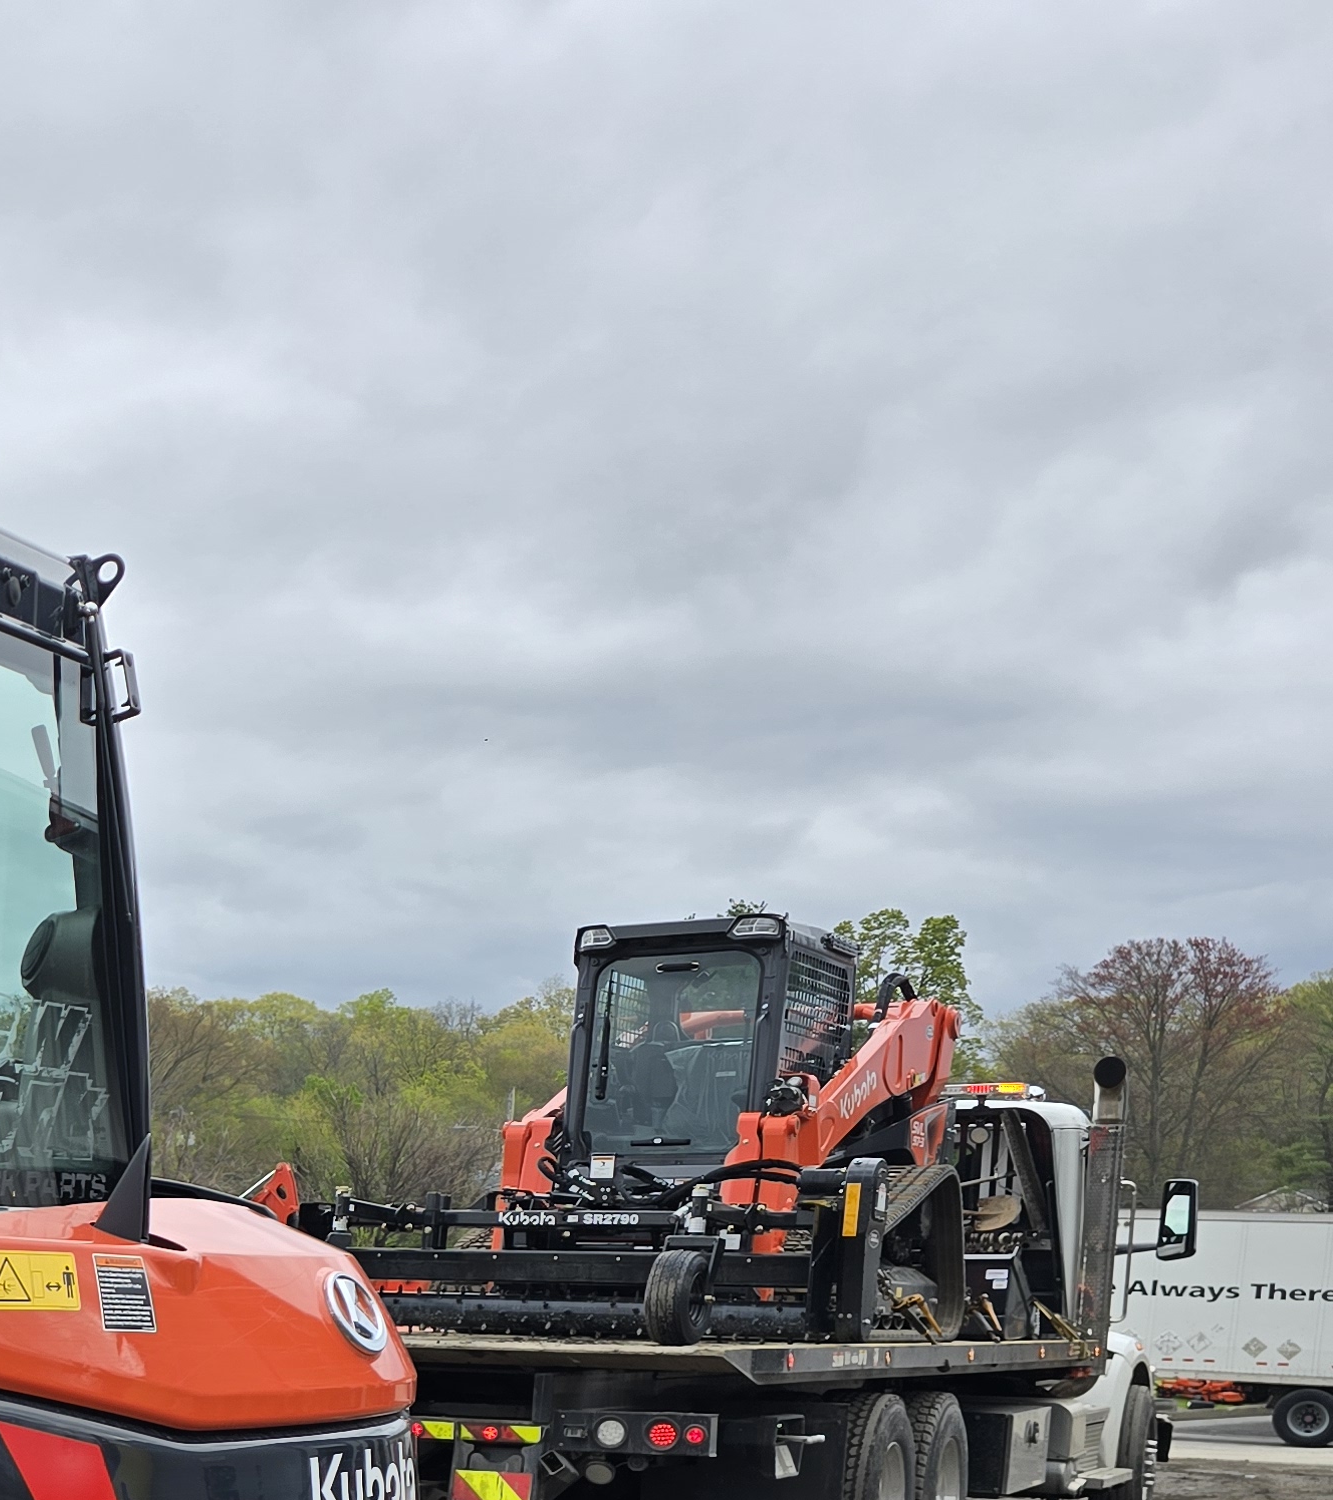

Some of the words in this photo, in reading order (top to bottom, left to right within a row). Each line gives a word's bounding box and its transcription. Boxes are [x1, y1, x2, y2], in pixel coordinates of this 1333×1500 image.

[839, 1070, 877, 1120] Kubota
[498, 1211, 556, 1226] Kubota
[583, 1213, 639, 1225] SR2790
[1127, 1280, 1240, 1303] Always
